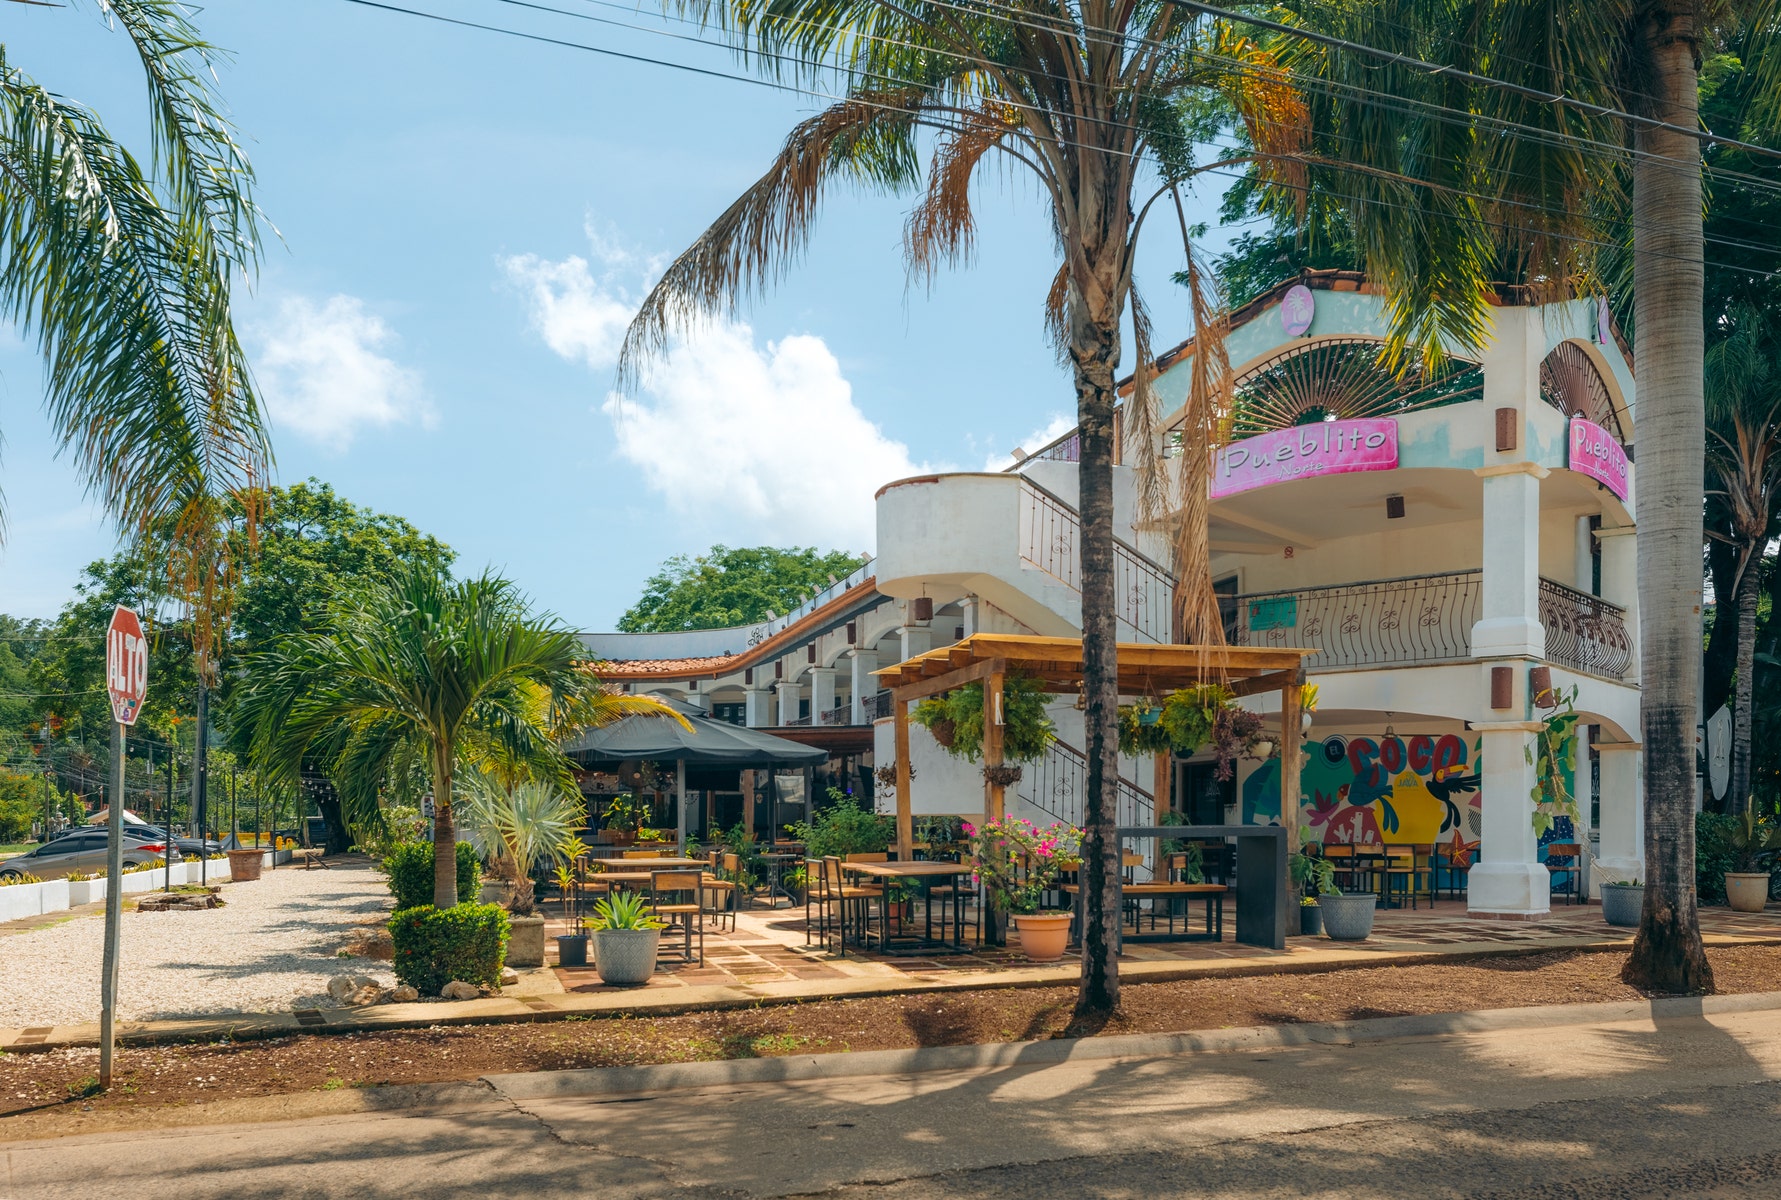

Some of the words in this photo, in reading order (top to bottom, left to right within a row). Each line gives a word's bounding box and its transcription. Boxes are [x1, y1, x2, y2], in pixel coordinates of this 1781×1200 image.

[1221, 425, 1386, 477] Pueblito
[1278, 462, 1324, 480] Norte
[1574, 424, 1626, 478] Pueblito
[109, 629, 147, 699] ALTO
[1347, 734, 1468, 788] COCO
